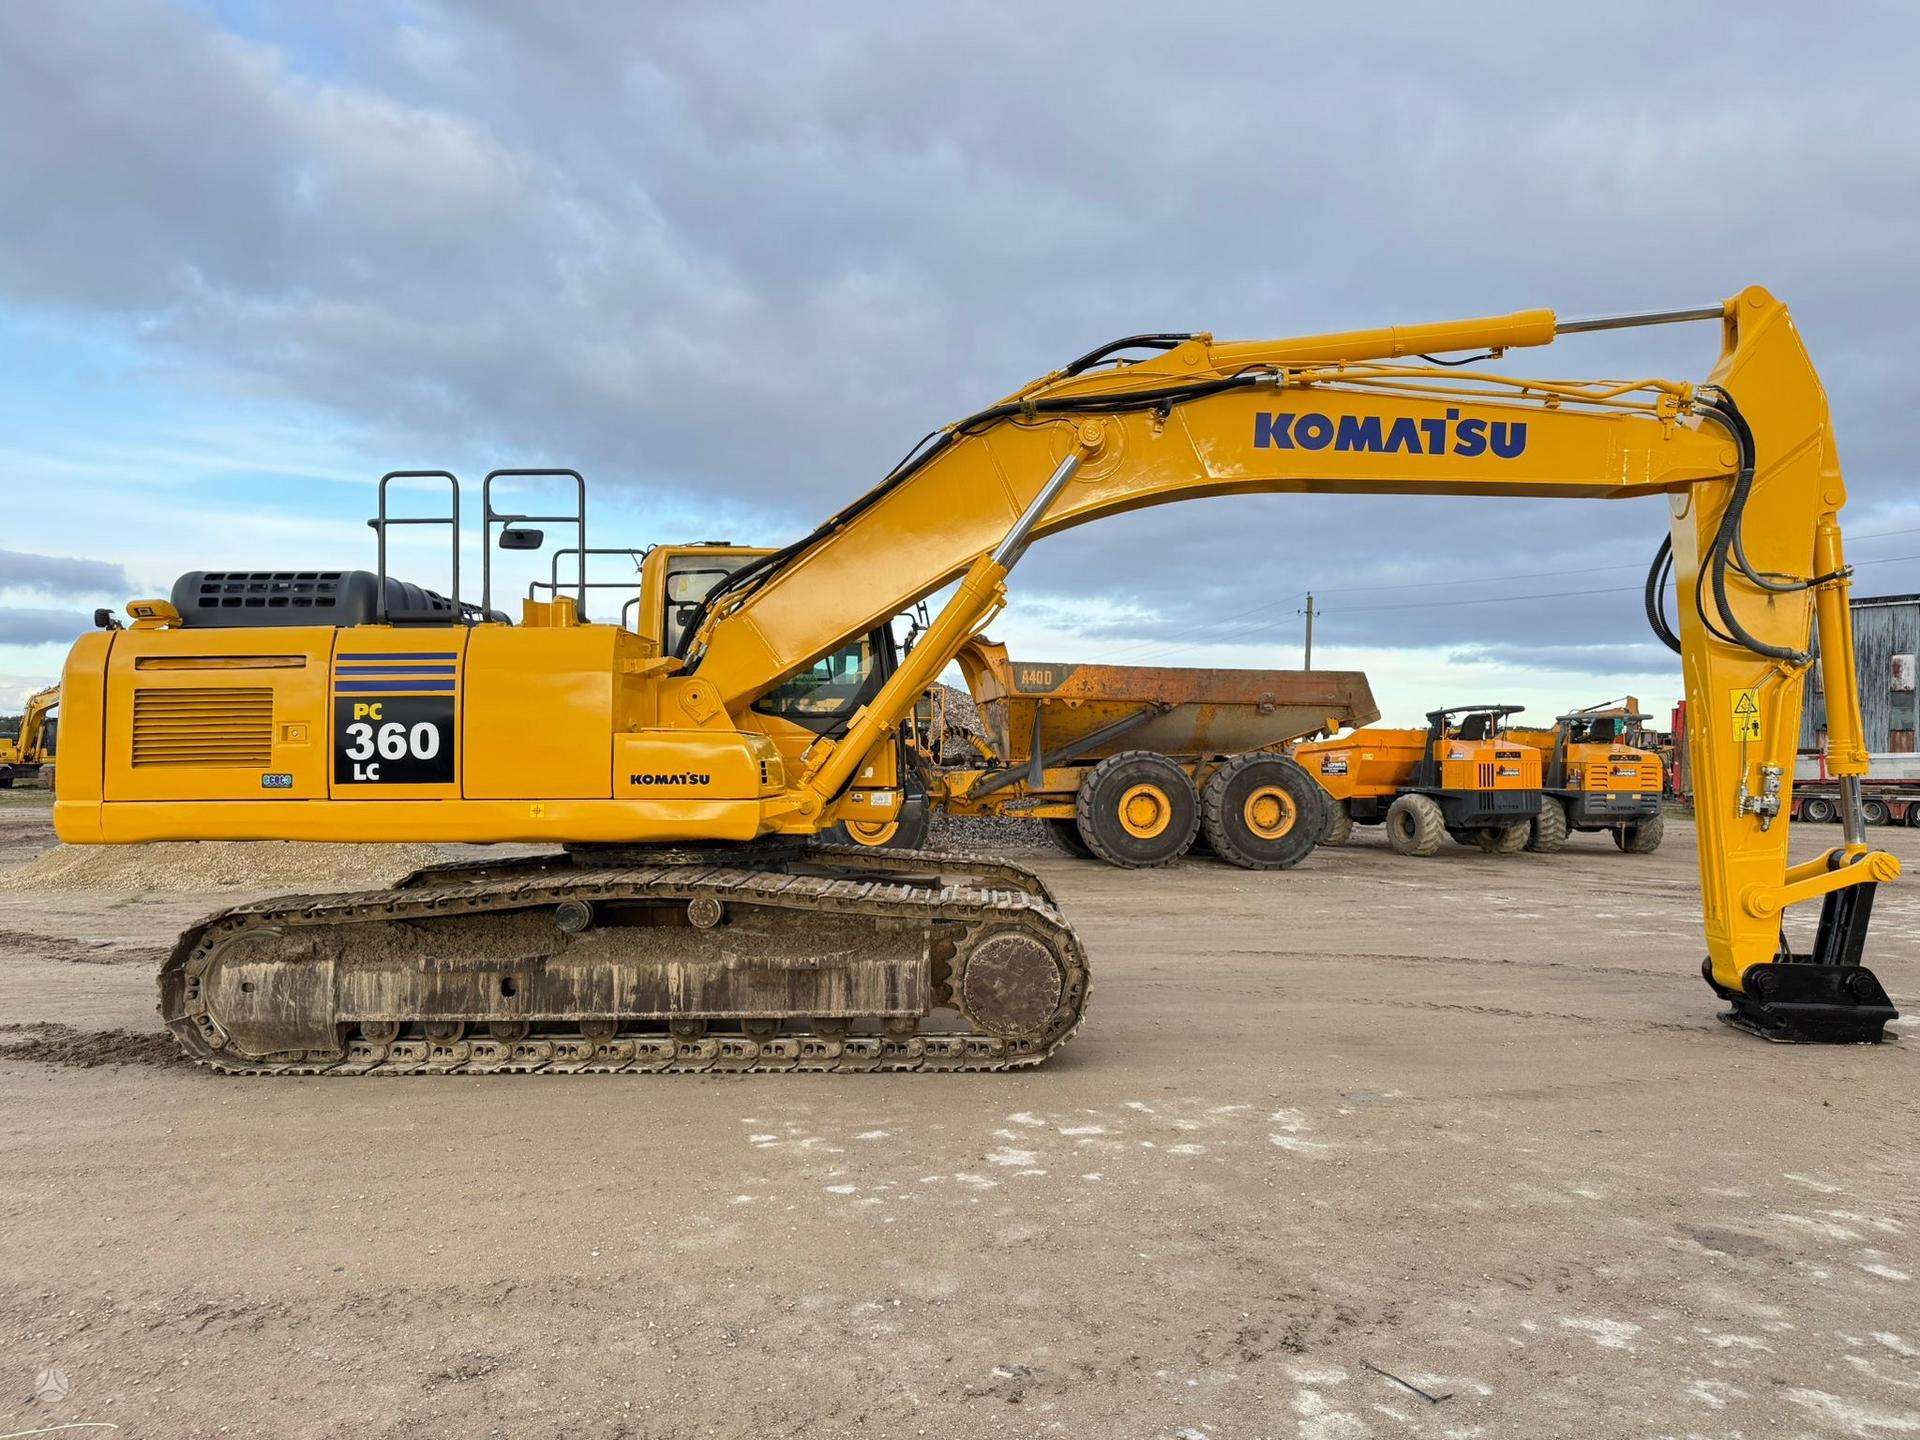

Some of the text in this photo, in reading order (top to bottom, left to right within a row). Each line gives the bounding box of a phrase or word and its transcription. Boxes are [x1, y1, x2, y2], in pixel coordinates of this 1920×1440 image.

[1254, 409, 1527, 459] KOMATSU
[1022, 670, 1052, 685] A40D
[354, 703, 382, 720] PC
[345, 722, 440, 760] 360
[353, 763, 380, 780] LC
[630, 772, 710, 785] KOMATSU
